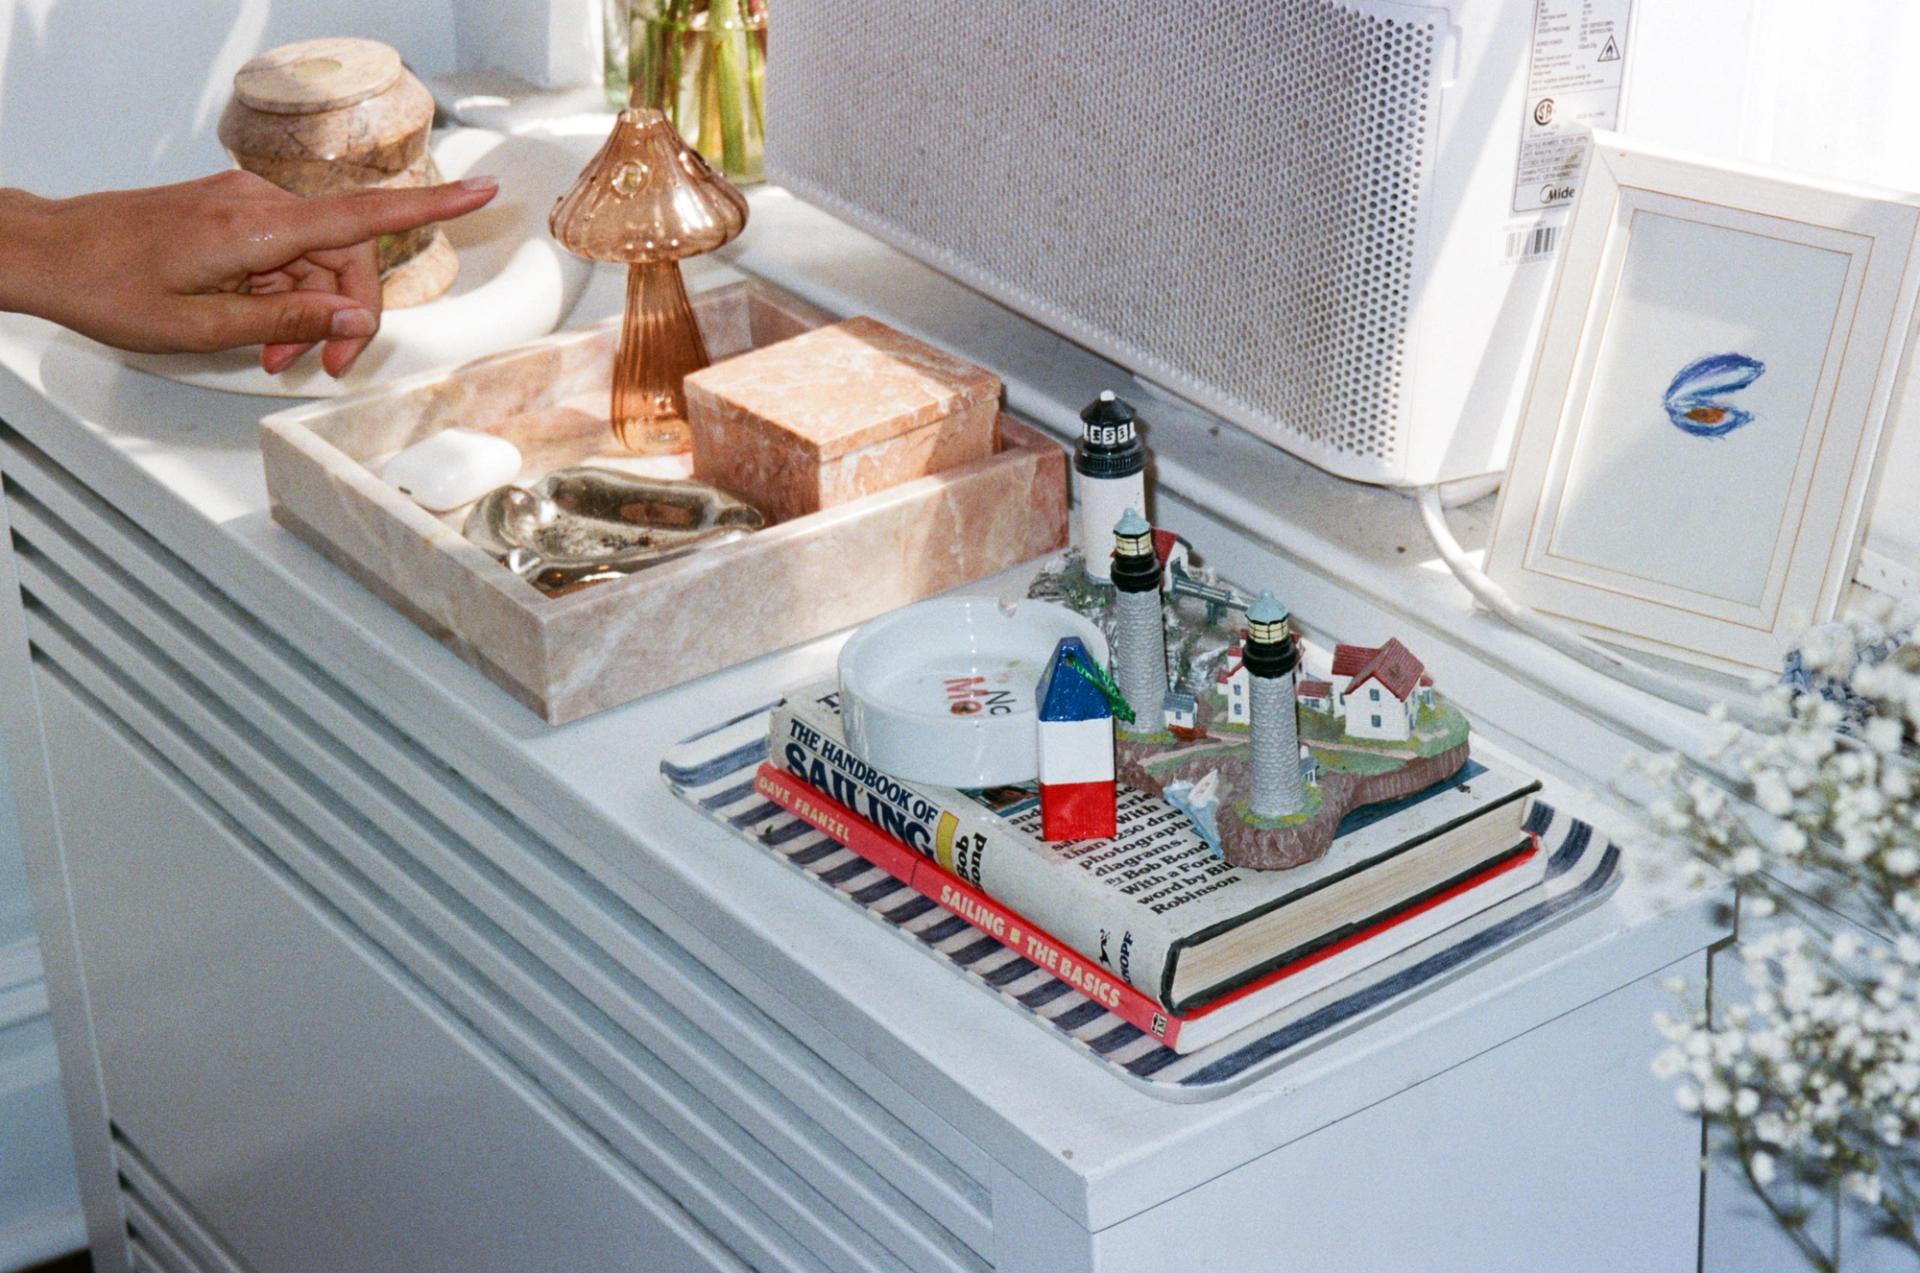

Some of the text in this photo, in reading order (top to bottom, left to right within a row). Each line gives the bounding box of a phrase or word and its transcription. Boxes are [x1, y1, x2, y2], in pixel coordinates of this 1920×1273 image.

[790, 718, 939, 825] THE HANDBOOK OF
[758, 775, 851, 842] DAVE FRANZEL
[785, 742, 935, 859] SAILING
[1116, 803, 1161, 825] With
[1062, 842, 1107, 860] than
[1095, 838, 1189, 877] diagrams.
[1121, 862, 1163, 881] Bob
[1160, 840, 1210, 865] Bond
[1119, 874, 1168, 896] With
[1167, 869, 1181, 879] a
[1136, 881, 1184, 906] word
[1181, 872, 1208, 887] by
[1149, 874, 1243, 916] Robinson
[940, 885, 1121, 1008] SAILING THE BASICS
